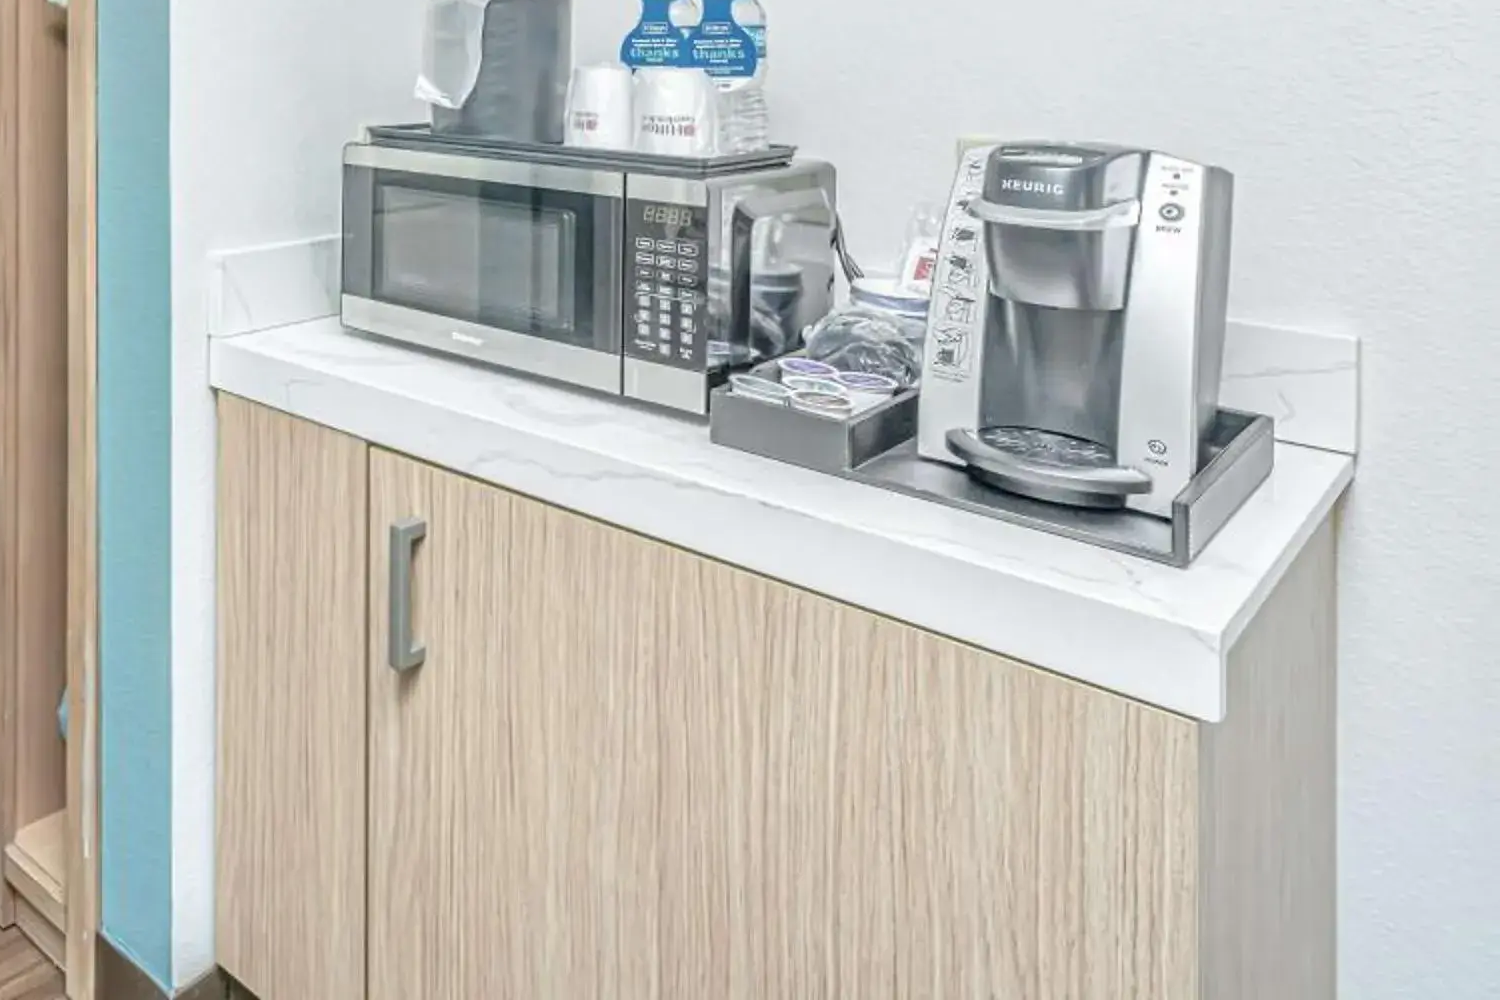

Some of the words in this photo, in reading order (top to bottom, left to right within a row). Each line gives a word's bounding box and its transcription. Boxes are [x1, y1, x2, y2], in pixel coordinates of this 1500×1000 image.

[630, 47, 680, 59] thanks
[692, 48, 745, 60] thanks
[1001, 178, 1065, 195] KEURIG
